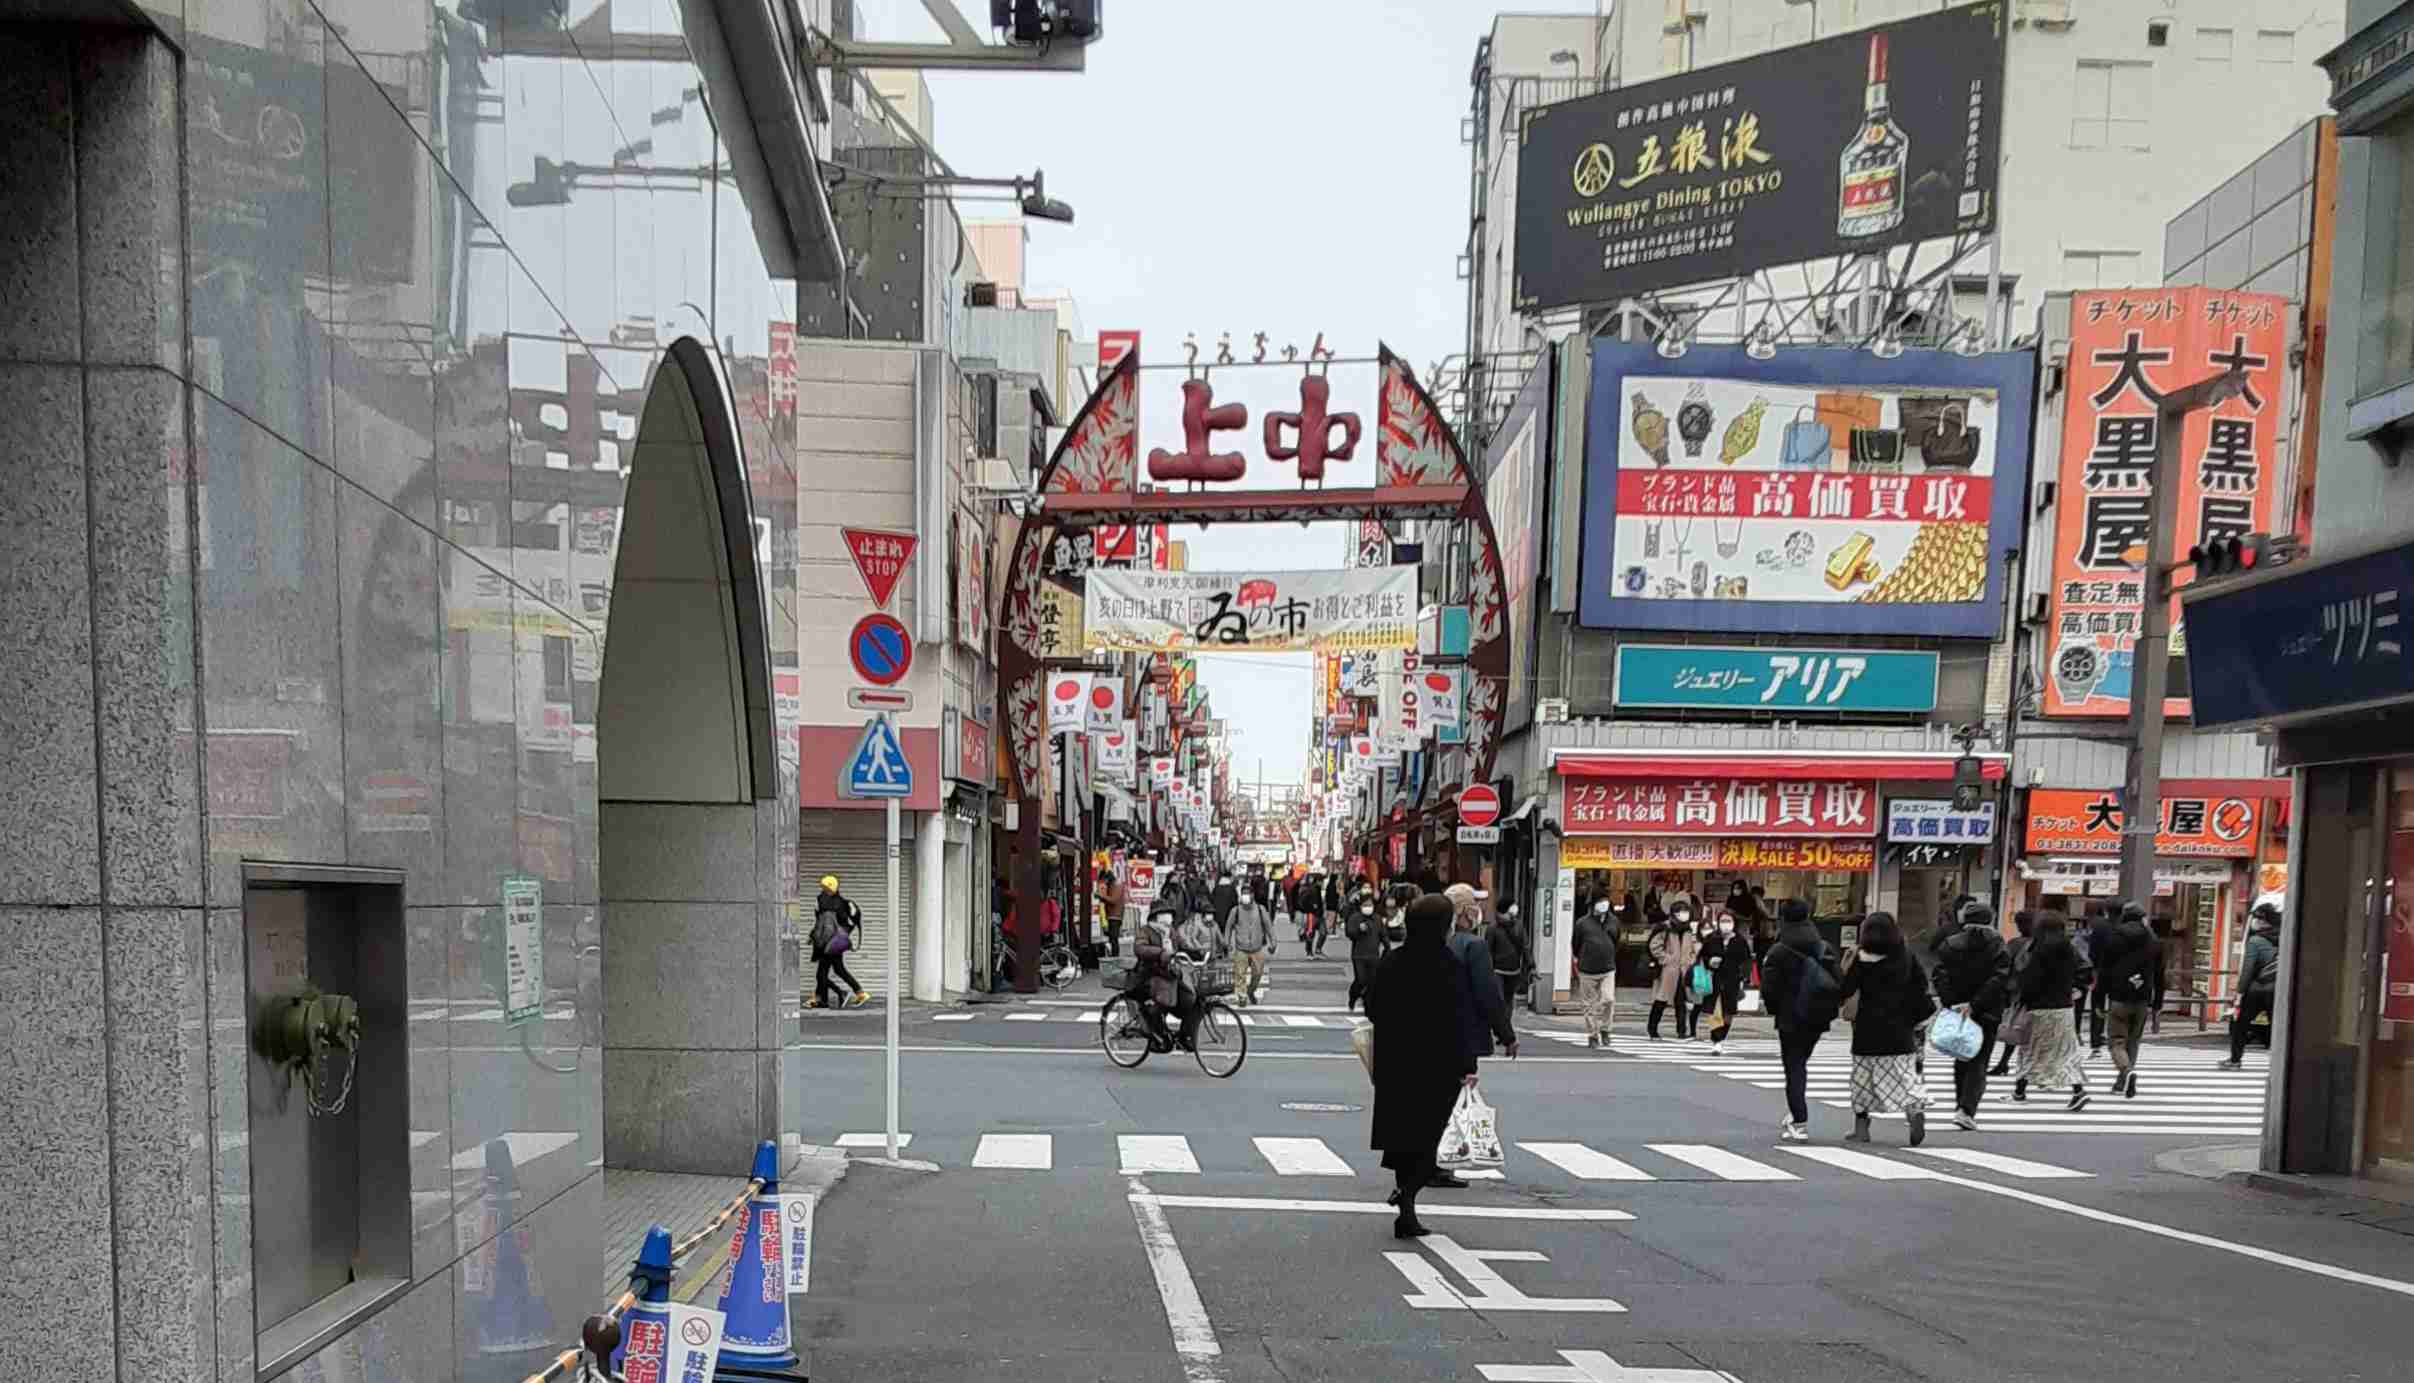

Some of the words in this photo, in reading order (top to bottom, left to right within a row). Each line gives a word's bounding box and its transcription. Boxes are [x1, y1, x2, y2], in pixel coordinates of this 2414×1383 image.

[1567, 198, 1651, 226] Wuliangye
[1656, 186, 1711, 212] Dining
[1718, 169, 1782, 199] TOKYO
[2087, 297, 2184, 323] チケット
[2204, 300, 2276, 329] チケット
[1148, 375, 1361, 484] 上中
[1641, 474, 1736, 495] ブランド品
[1752, 473, 1967, 519] 高価買取
[1641, 494, 1736, 515] 宝石・貴金属
[859, 537, 903, 558] 止まれ
[866, 561, 897, 577] STOP
[2063, 580, 2146, 606] 査定無
[2059, 610, 2148, 638] 高価買
[2323, 589, 2401, 665] ツツミ
[1672, 666, 1756, 689] ジュエリー
[1760, 655, 1866, 702] アリア
[1573, 784, 1667, 802] ブランド品
[1675, 780, 1867, 827] 高価買取
[1572, 803, 1667, 822] 宝石・貴金属
[2031, 815, 2078, 834] チケット
[1892, 817, 1991, 838] 高価買取
[1758, 851, 1796, 866] SALE
[1799, 841, 1832, 866] 50
